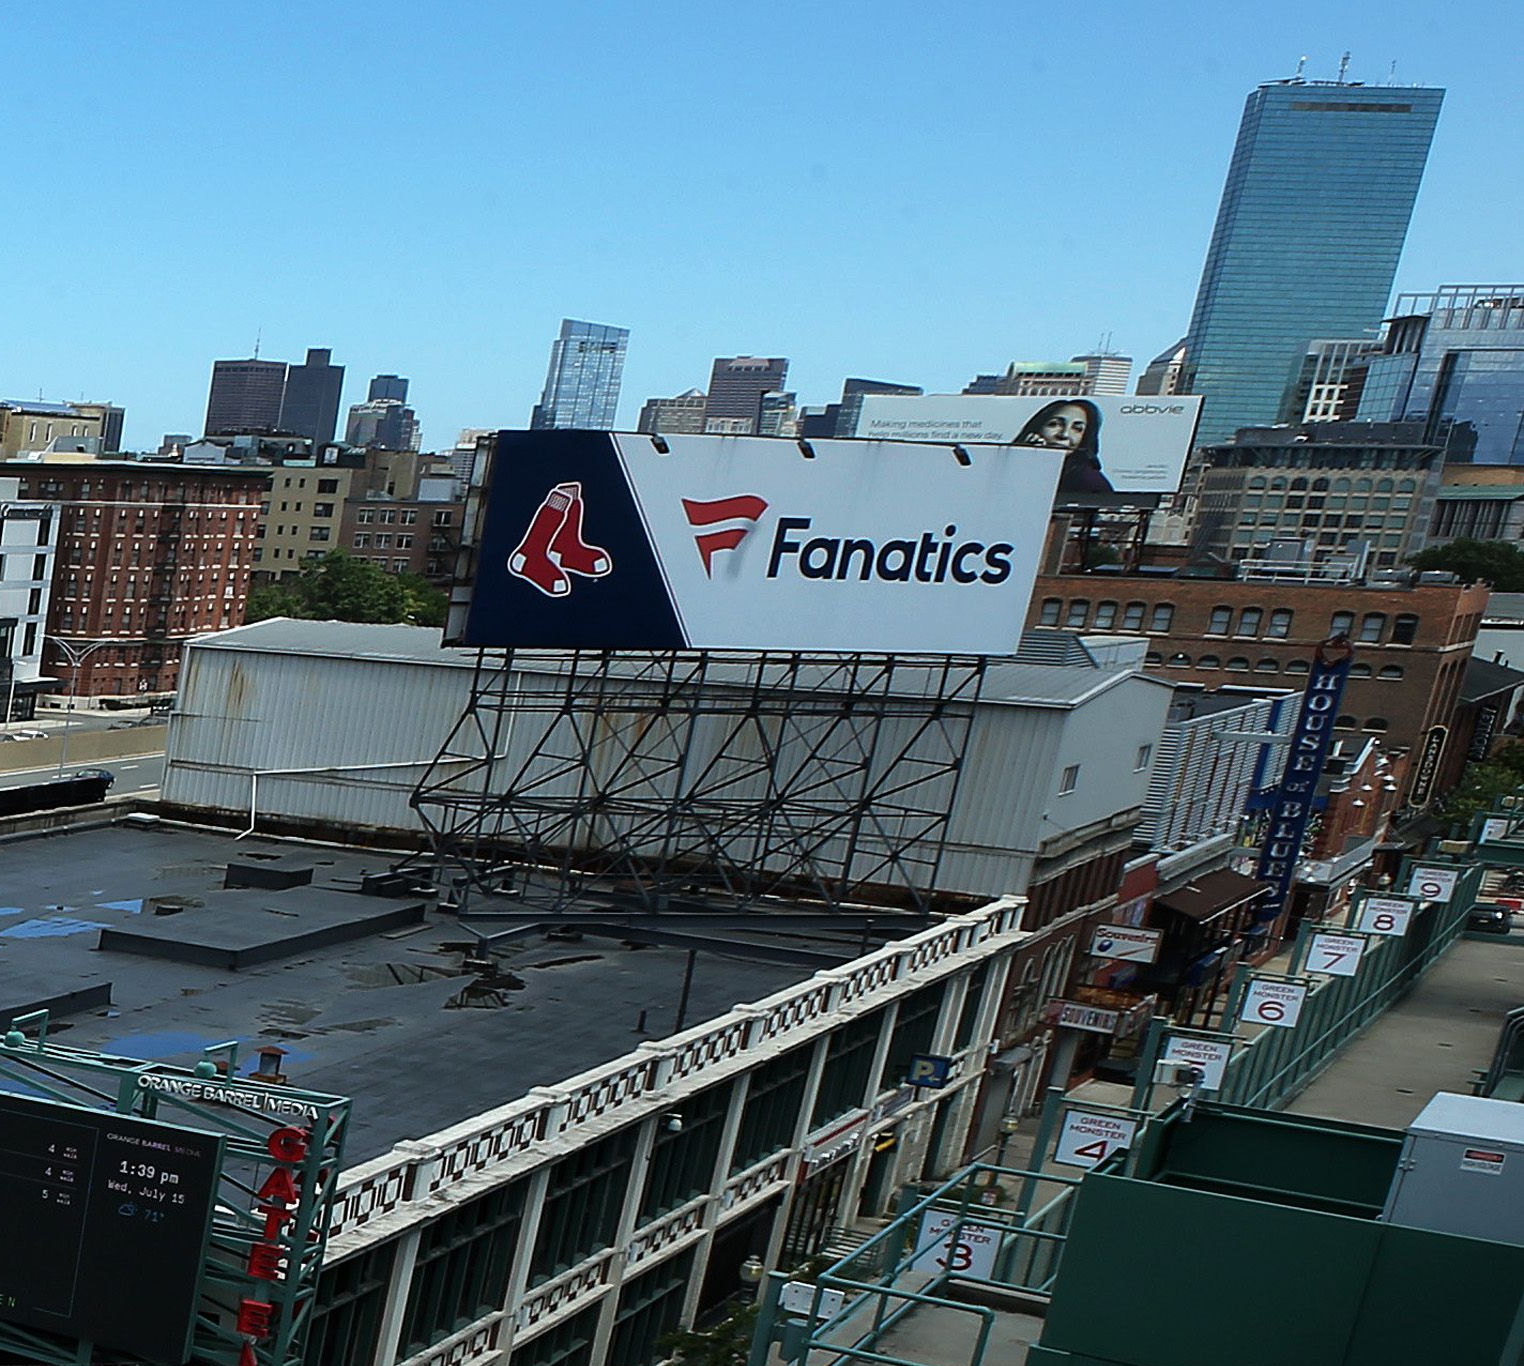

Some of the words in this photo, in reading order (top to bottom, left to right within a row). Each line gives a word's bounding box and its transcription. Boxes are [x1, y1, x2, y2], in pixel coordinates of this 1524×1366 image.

[1119, 403, 1184, 415] abbvie
[871, 420, 906, 430] Making
[908, 420, 961, 429] medicines
[962, 420, 982, 429] that
[766, 517, 1015, 585] Fanatics
[1294, 674, 1340, 771] HOUSE
[1265, 801, 1302, 898] BLUES
[1420, 882, 1442, 898] 9
[1373, 914, 1395, 931] 8
[1316, 942, 1359, 952] MONSTER
[1324, 937, 1354, 945] GREEN
[1323, 951, 1347, 969] 7
[1253, 990, 1299, 1002] MONSTER
[1261, 983, 1295, 993] GREEN
[1257, 1000, 1286, 1021] 6
[1171, 1048, 1223, 1061] MONSTER
[1180, 1041, 1218, 1052] GREEN
[912, 1060, 935, 1081] P
[137, 1074, 203, 1099] ORANGE
[203, 1086, 261, 1110] BARREL
[267, 1096, 320, 1120] MEDIA
[1069, 1123, 1128, 1141] MONSTER
[1080, 1116, 1121, 1131] GREEN
[48, 1143, 55, 1153] 4
[106, 1132, 141, 1146] ORANGE
[141, 1138, 172, 1152] BARREL
[174, 1146, 202, 1158] MEDIA
[1074, 1140, 1109, 1161] 4
[44, 1166, 52, 1176] 4
[118, 1160, 157, 1179] 1:39
[160, 1172, 180, 1185] pm
[41, 1189, 49, 1199] 5
[138, 1185, 166, 1203] July
[170, 1193, 186, 1205] 15
[247, 1126, 309, 1281] GATE
[144, 1209, 166, 1224] 71°
[935, 1242, 973, 1271] 3
[236, 1298, 273, 1339] E
